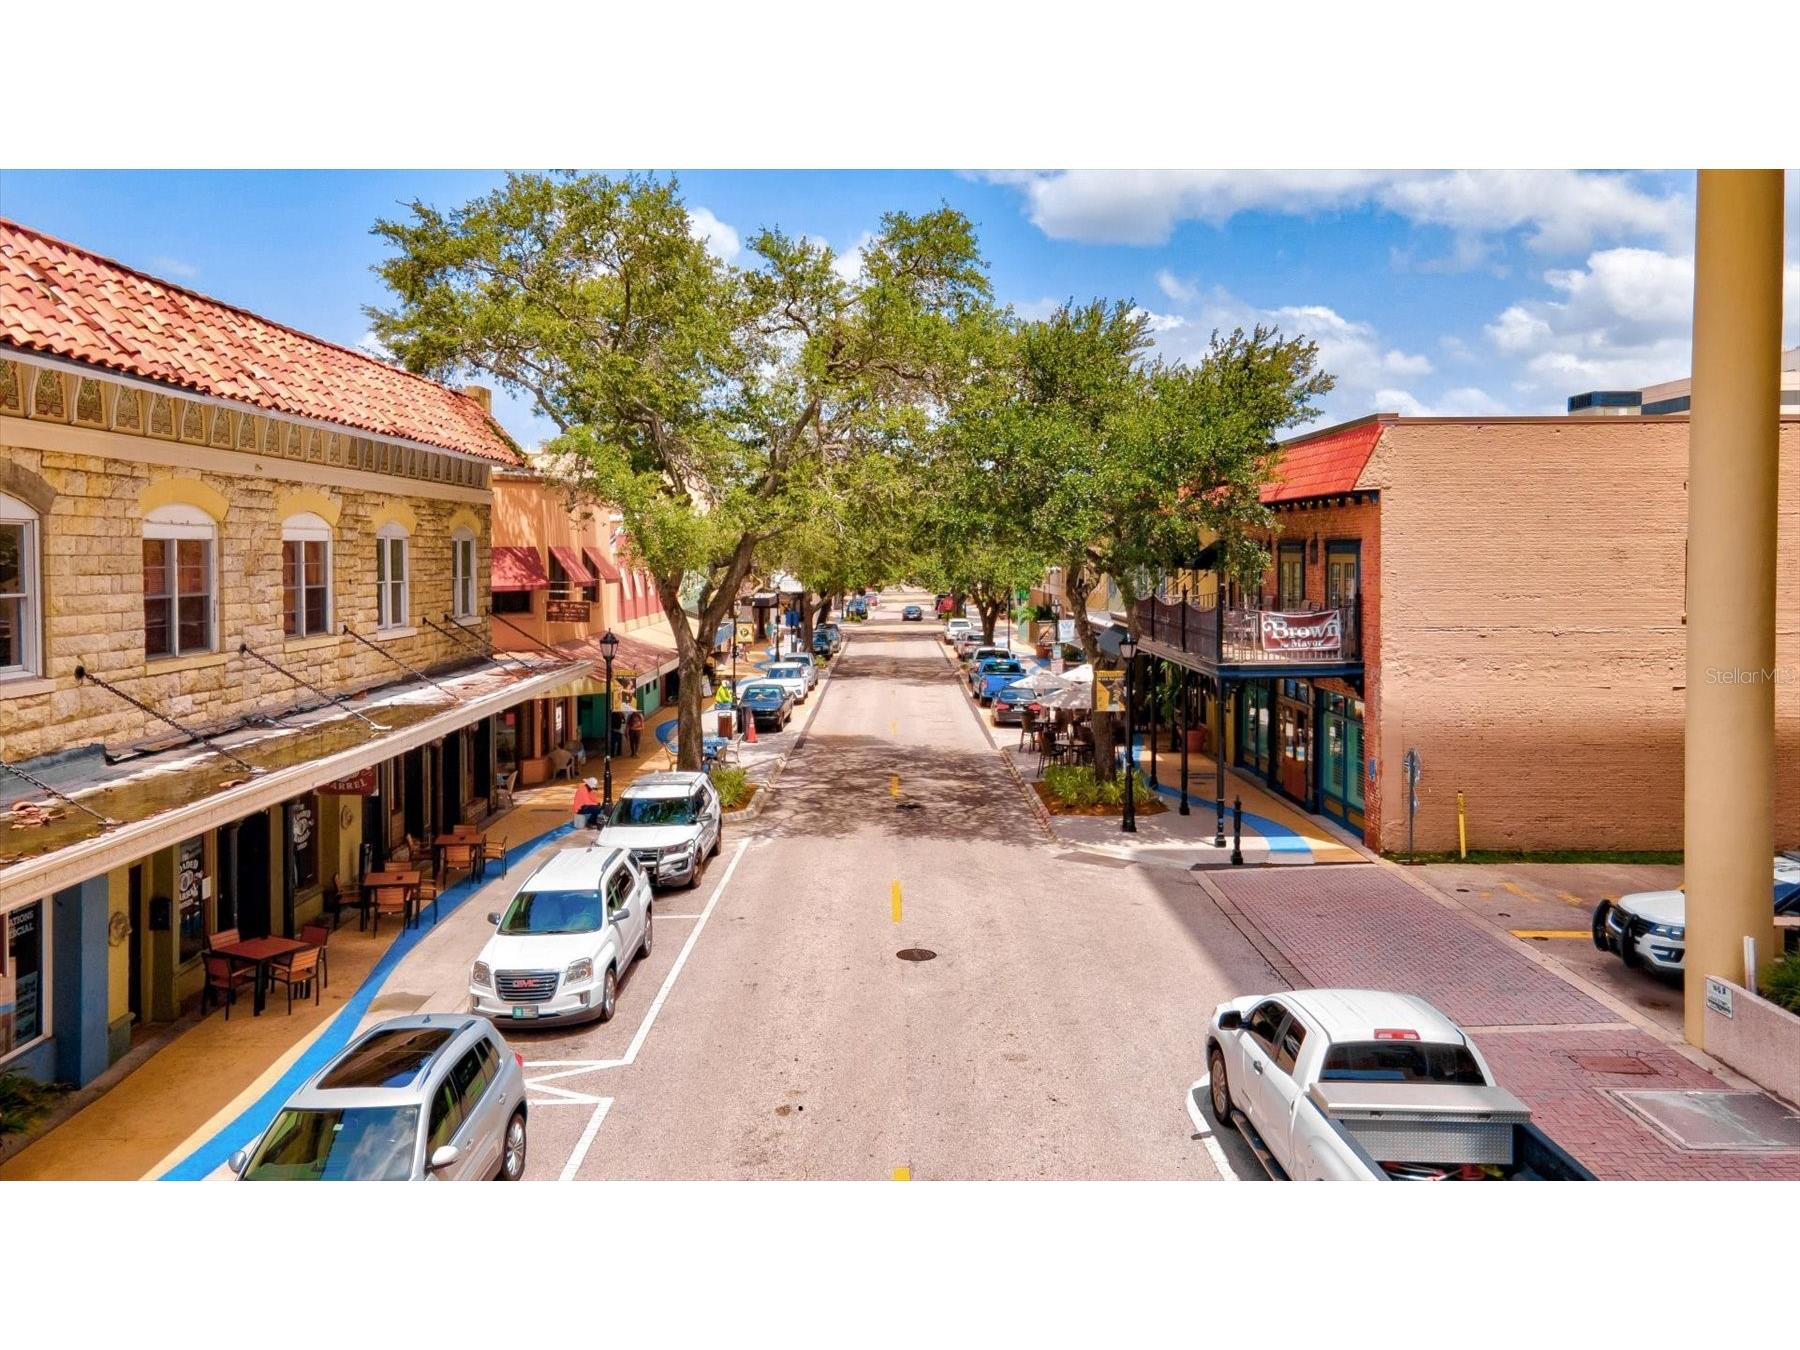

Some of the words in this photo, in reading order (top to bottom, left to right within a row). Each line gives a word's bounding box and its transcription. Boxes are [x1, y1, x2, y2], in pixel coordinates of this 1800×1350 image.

[1263, 619, 1339, 640] Brown
[1291, 639, 1322, 648] Mayor
[329, 778, 368, 790] ARREL
[512, 979, 541, 988] GMC
